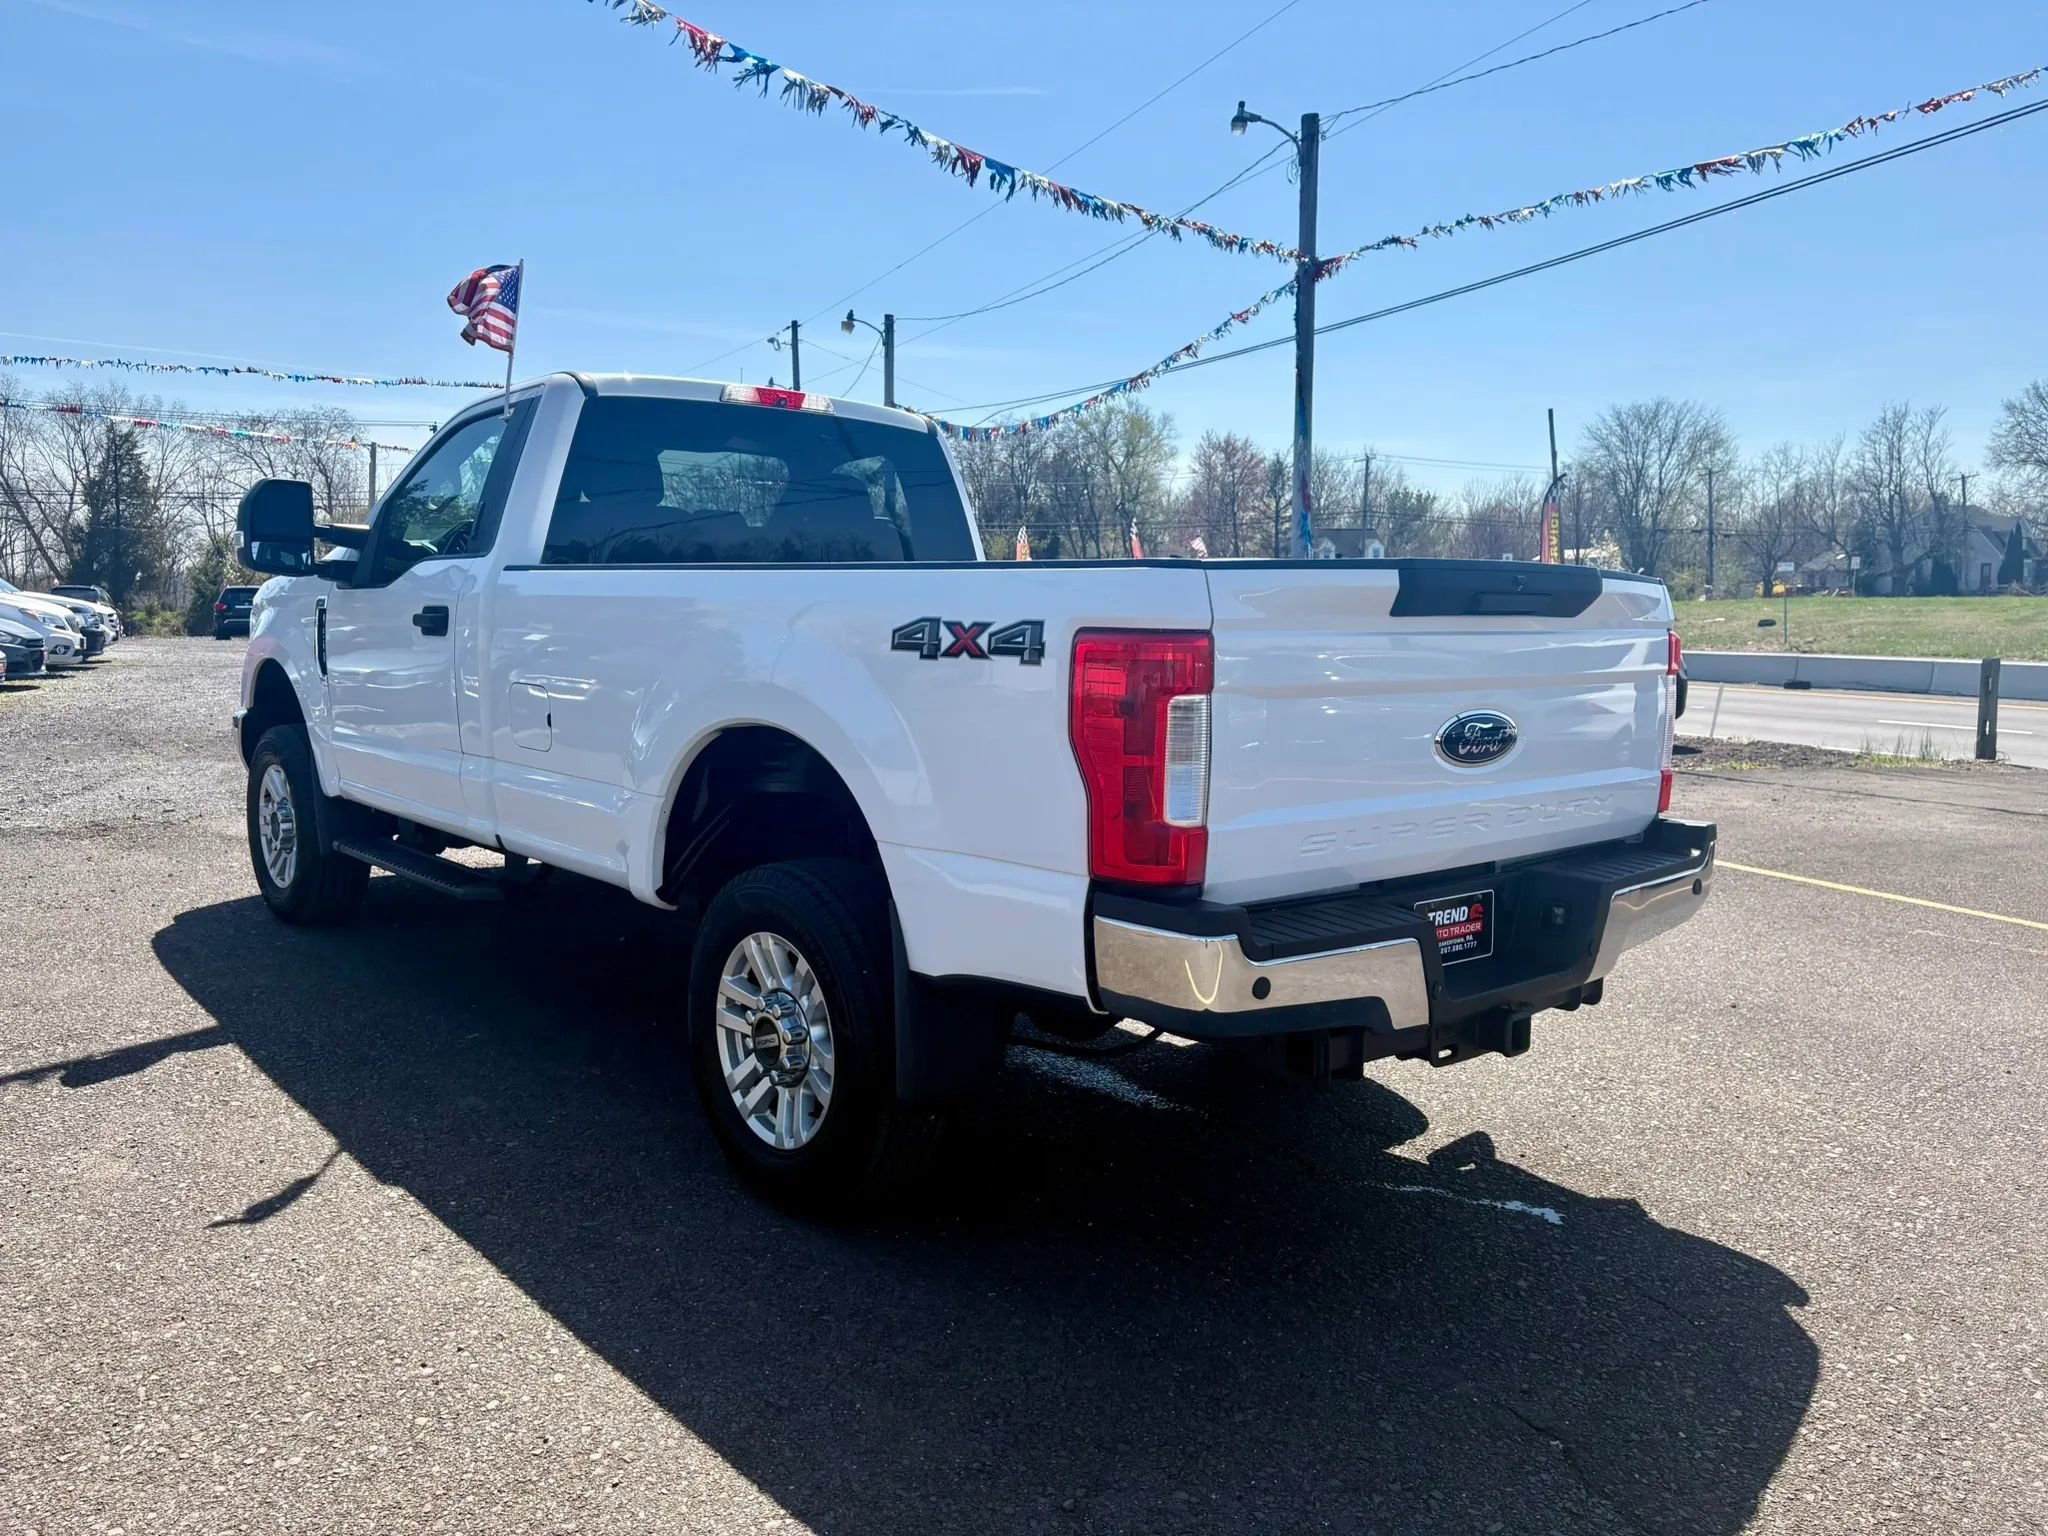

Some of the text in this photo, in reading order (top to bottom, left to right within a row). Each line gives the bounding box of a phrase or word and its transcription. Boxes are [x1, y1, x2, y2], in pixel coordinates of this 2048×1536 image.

[1458, 722, 1513, 755] Ford
[1299, 792, 1615, 856] SUPER DUTY
[1427, 906, 1469, 926] TREND
[1450, 922, 1481, 936] TRADER
